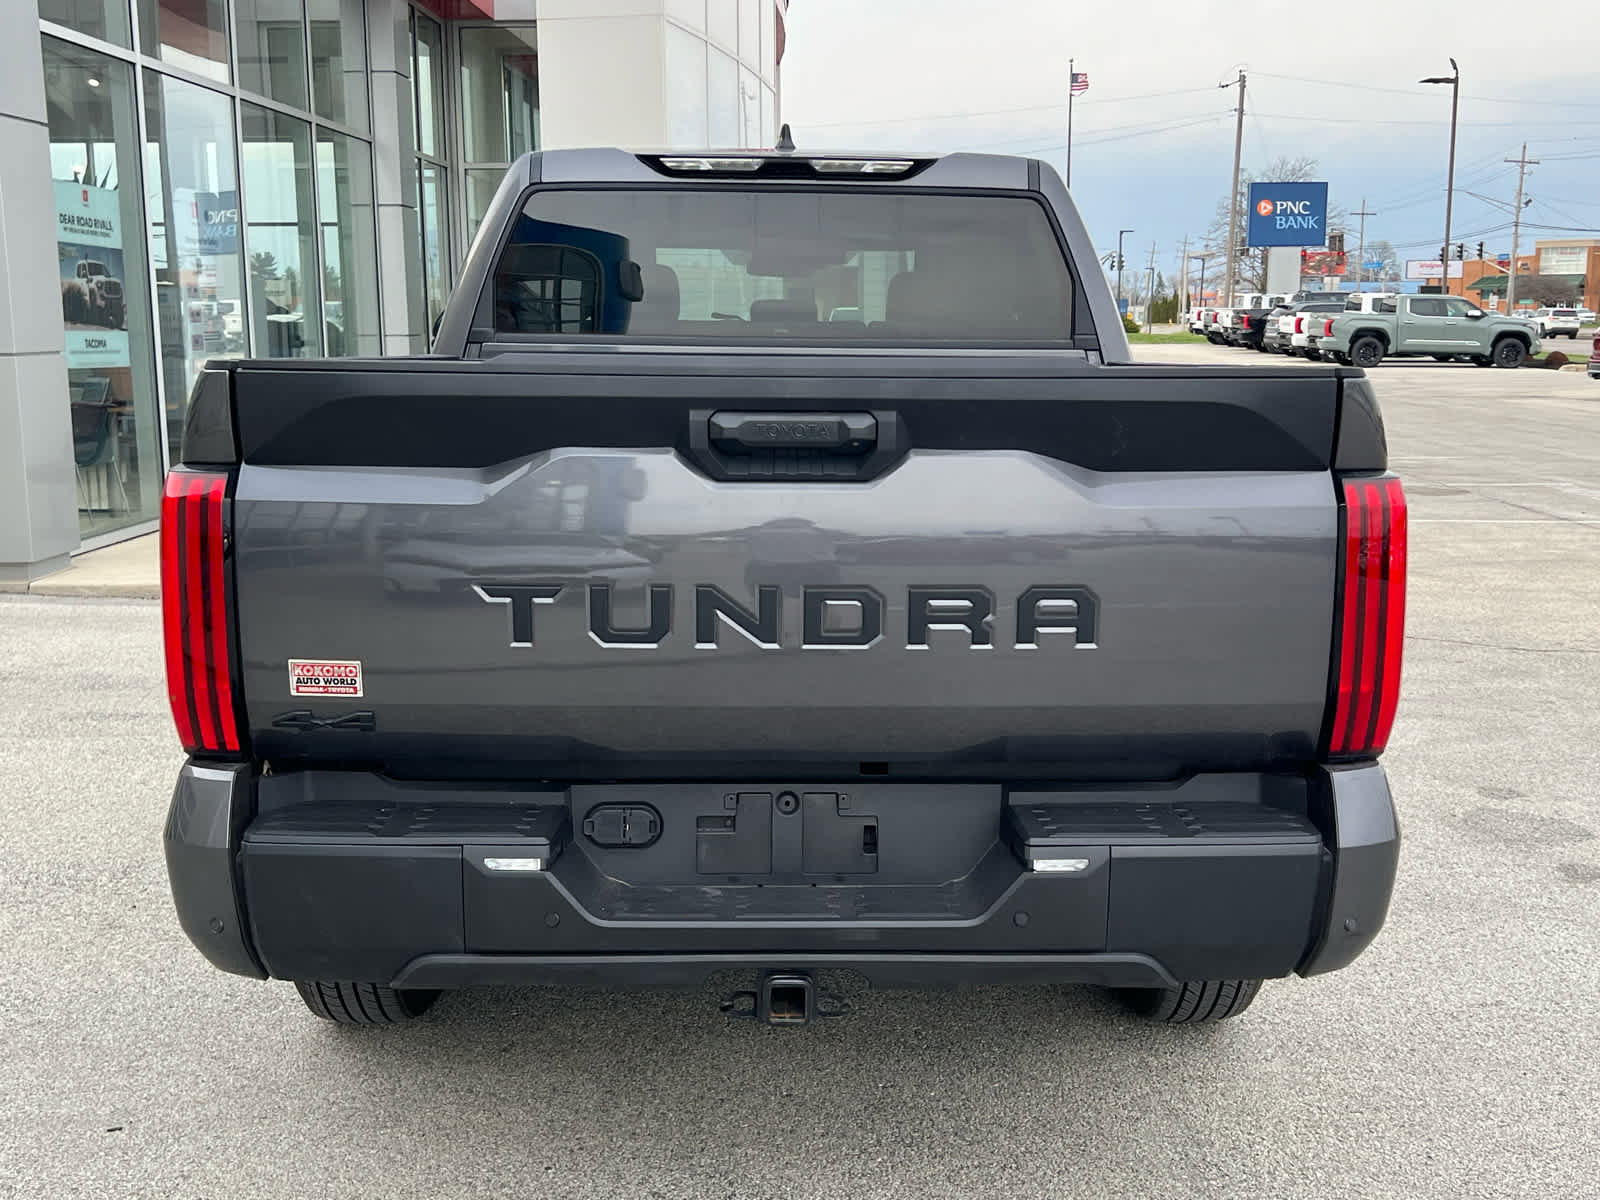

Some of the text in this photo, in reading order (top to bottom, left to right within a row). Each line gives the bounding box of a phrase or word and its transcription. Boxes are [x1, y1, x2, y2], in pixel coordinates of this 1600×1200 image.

[1275, 200, 1311, 215] PNC
[59, 212, 75, 225] DEAR
[76, 215, 93, 228] ROAD
[1275, 215, 1319, 230] BANK
[751, 422, 832, 440] TOYOTA
[471, 583, 1101, 650] TUNDRA
[294, 665, 357, 677] KOKOMO
[295, 677, 357, 686] AUTO WORLD
